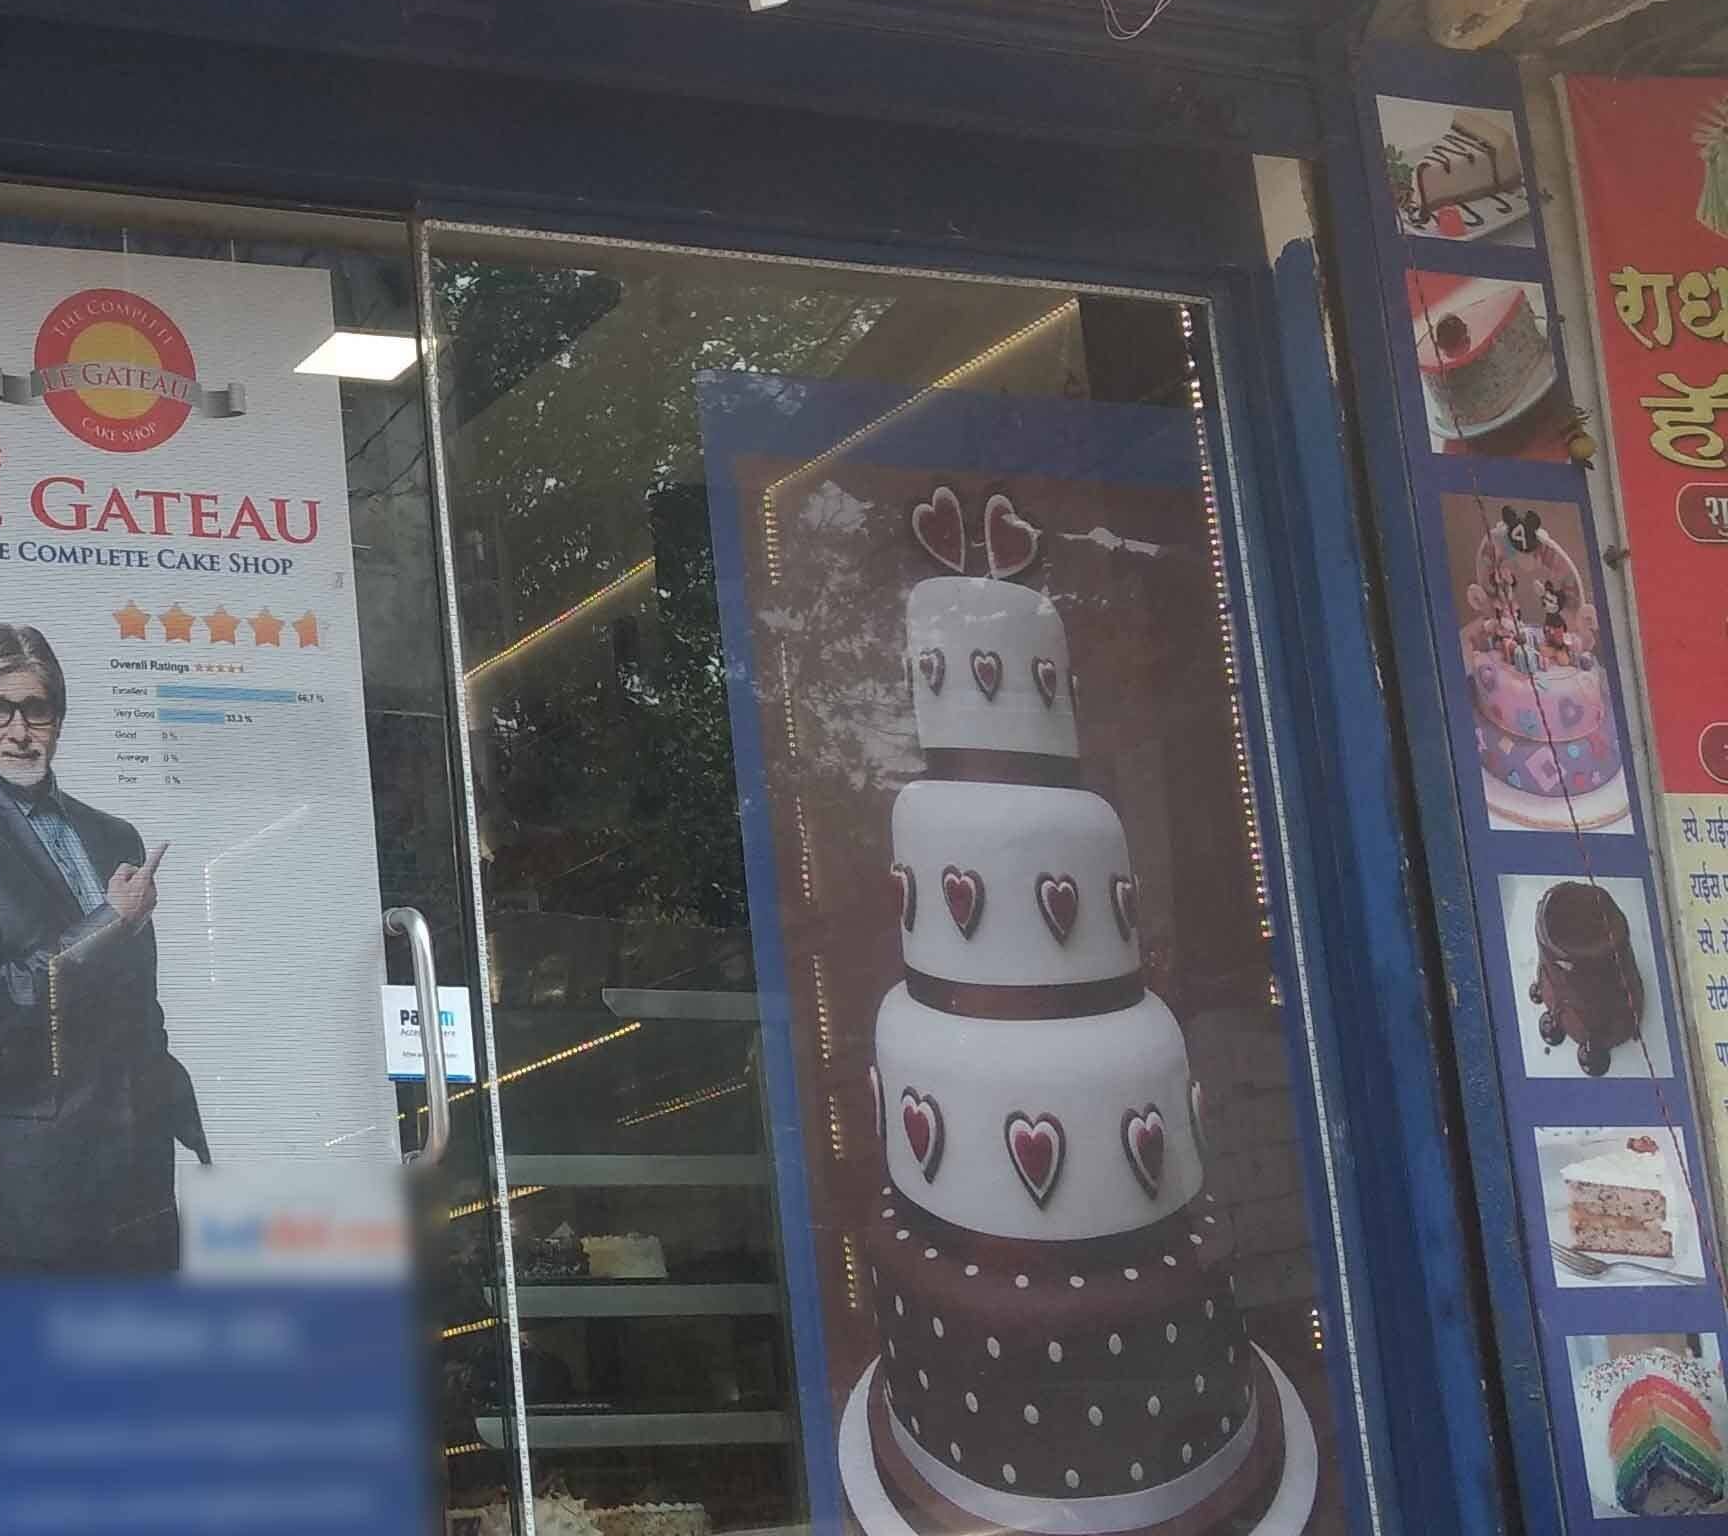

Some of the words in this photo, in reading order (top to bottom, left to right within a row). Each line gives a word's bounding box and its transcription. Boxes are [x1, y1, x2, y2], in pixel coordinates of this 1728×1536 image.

[52, 310, 83, 338] THE
[41, 367, 74, 392] LE
[81, 362, 189, 400] GATEAU
[81, 416, 117, 441] CAKE
[121, 421, 158, 442] SHOP
[29, 475, 322, 545] GATEAU
[18, 540, 150, 569] COMPLETE
[157, 548, 221, 573] CAKE
[228, 553, 294, 576] SHOP
[110, 658, 147, 670] Overall
[150, 660, 190, 673] Ratings
